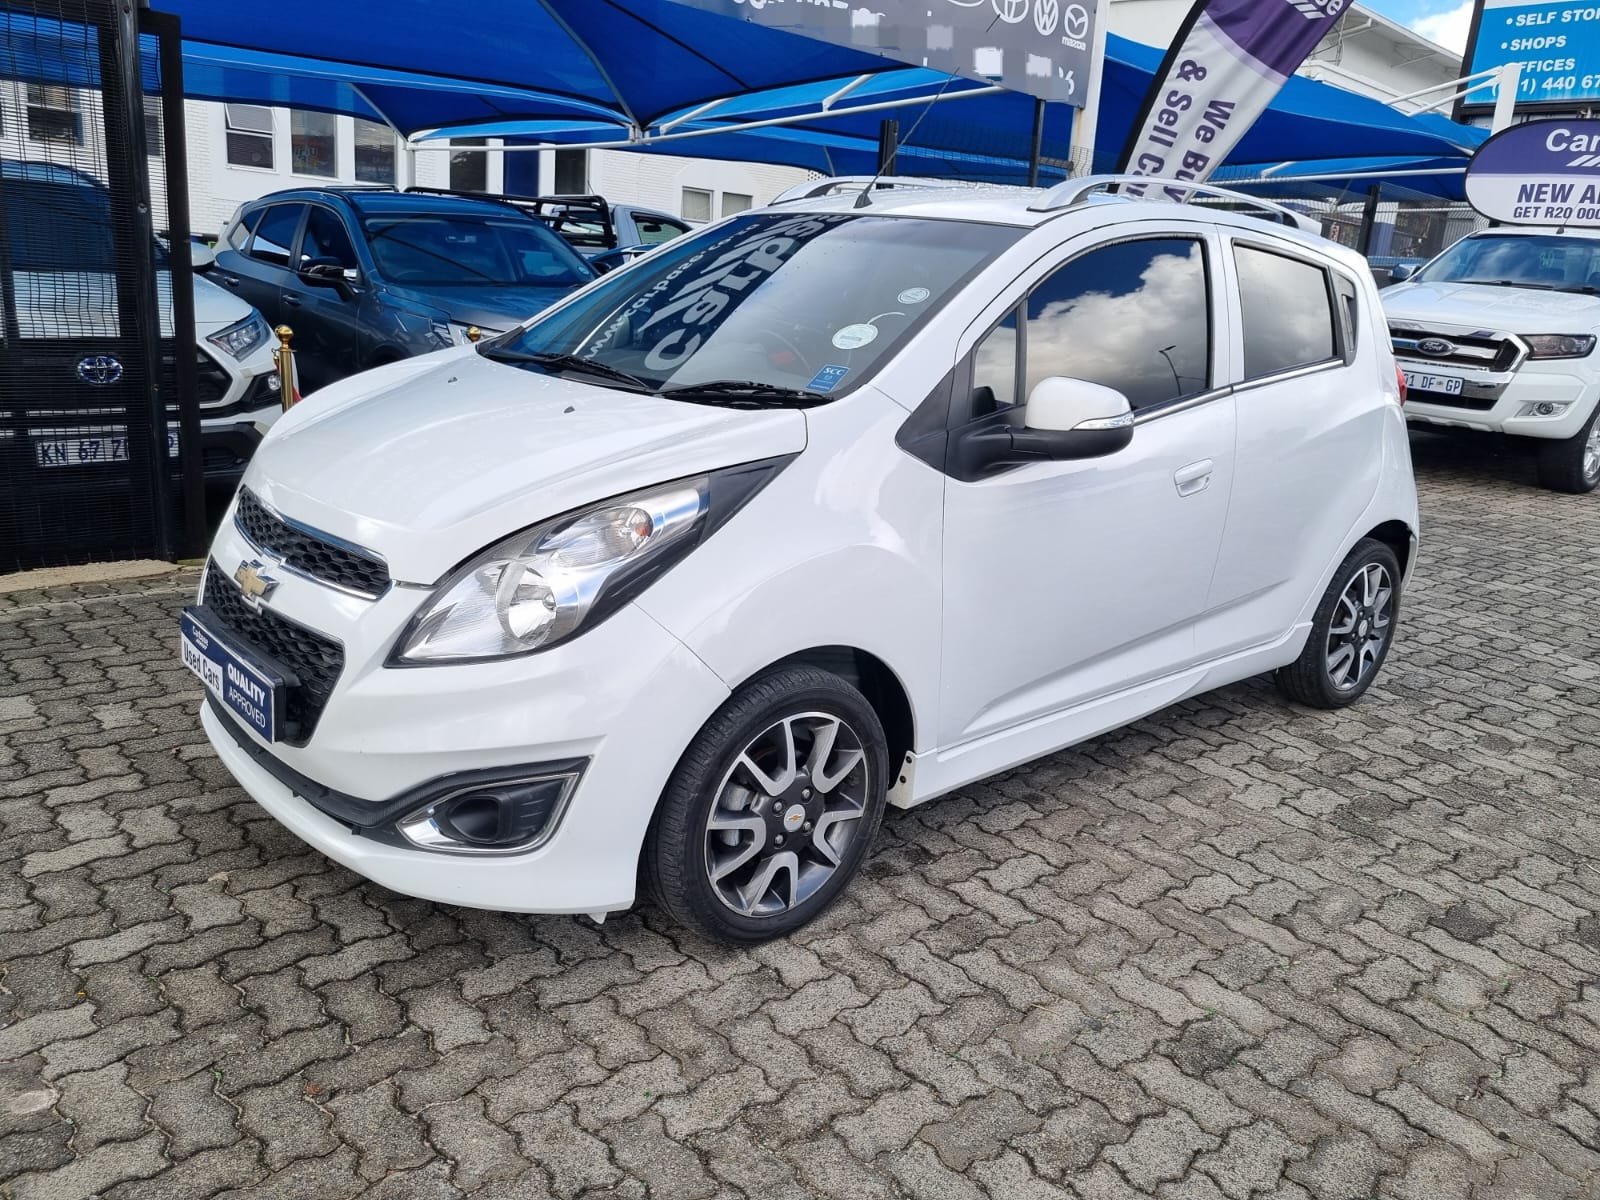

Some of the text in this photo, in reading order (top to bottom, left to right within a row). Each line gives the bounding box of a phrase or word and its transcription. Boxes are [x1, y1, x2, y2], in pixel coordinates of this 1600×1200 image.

[1515, 11, 1557, 27] SELF
[1510, 35, 1567, 51] SHOPS
[1175, 59, 1207, 82] &
[1519, 58, 1576, 73] FFICES
[1541, 76, 1576, 91] 440
[1148, 89, 1193, 148] Sell
[1195, 99, 1236, 144] We
[1517, 183, 1600, 205] NEW A
[1513, 206, 1541, 219] GET
[1544, 206, 1573, 220] R20
[1421, 376, 1436, 389] DF
[1446, 379, 1461, 393] GP
[184, 641, 220, 691] Used Cars
[227, 663, 265, 707] QUALITY
[228, 686, 266, 728] APPROVED
